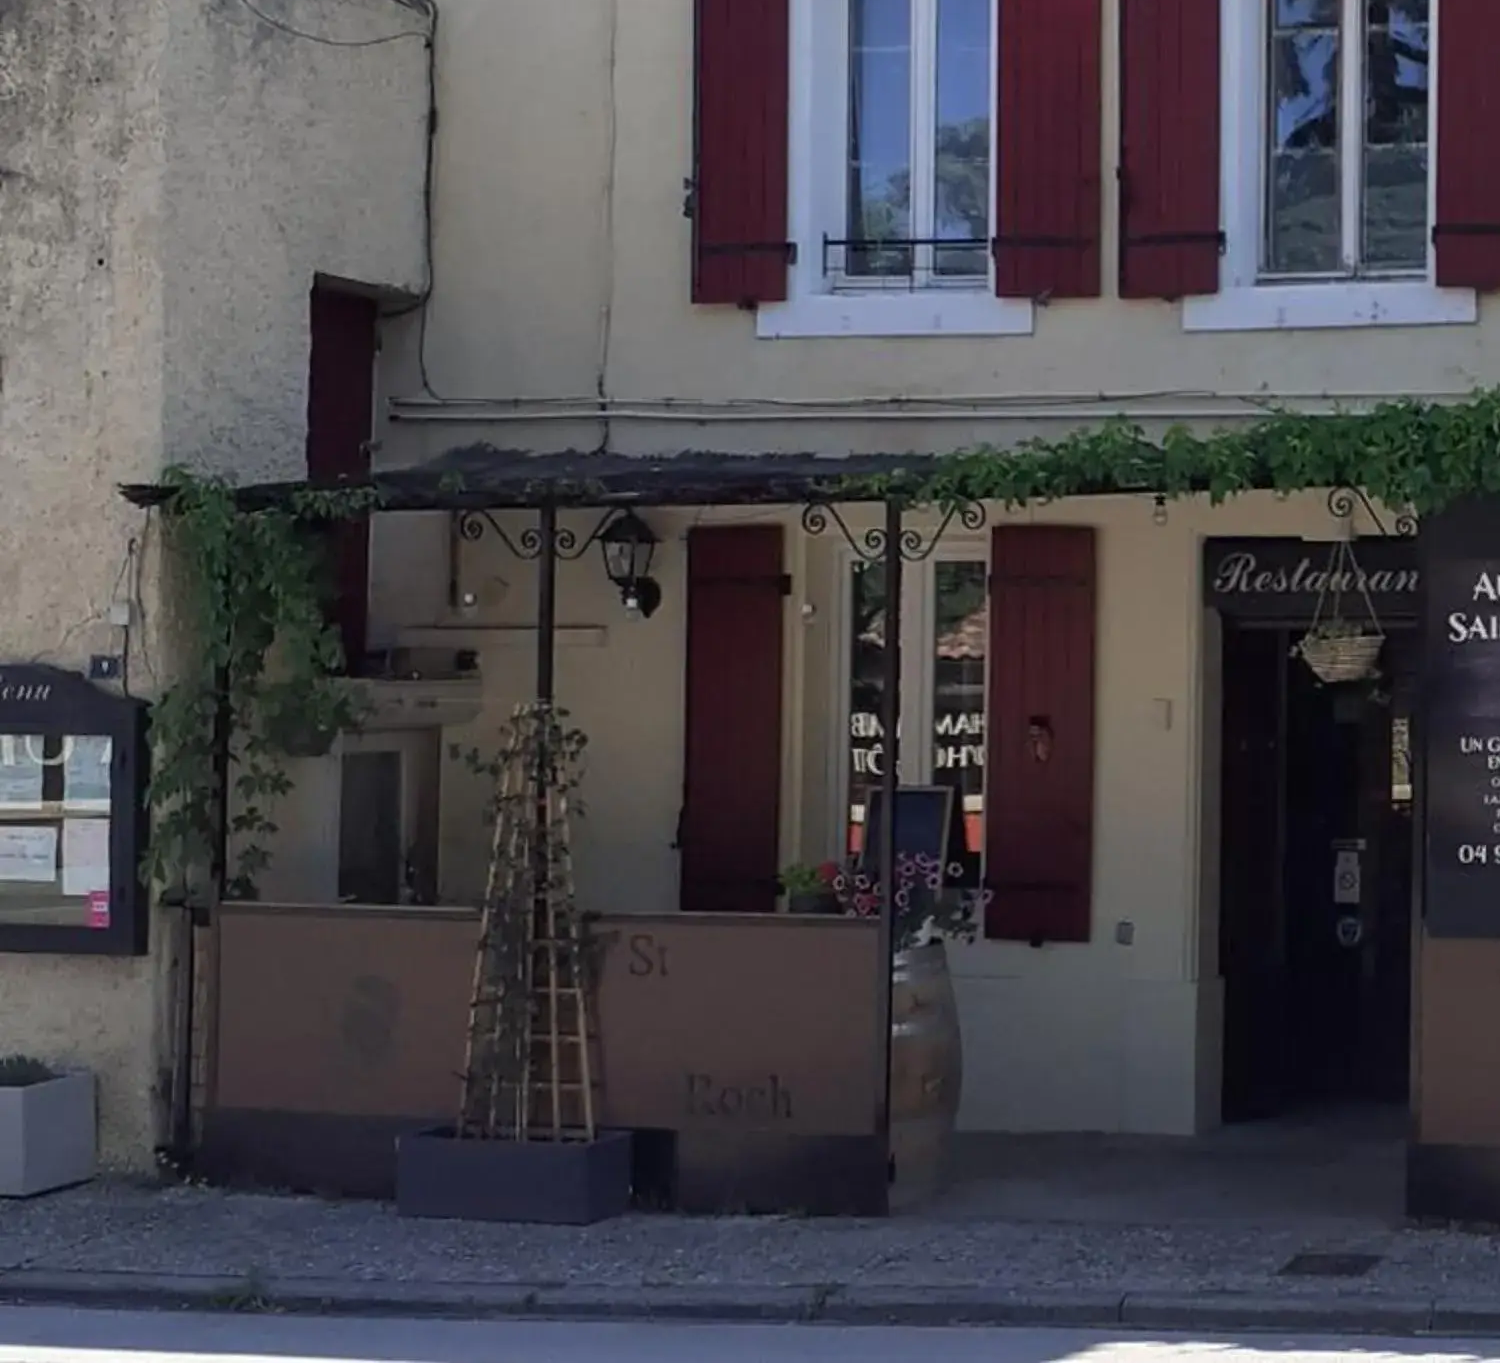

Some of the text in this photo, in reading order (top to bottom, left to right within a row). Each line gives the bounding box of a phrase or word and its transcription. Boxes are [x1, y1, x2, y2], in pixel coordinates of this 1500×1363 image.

[1213, 552, 1419, 593] Restauran
[0, 673, 51, 701] enu
[1460, 737, 1483, 753] UN
[1459, 844, 1488, 865] 04
